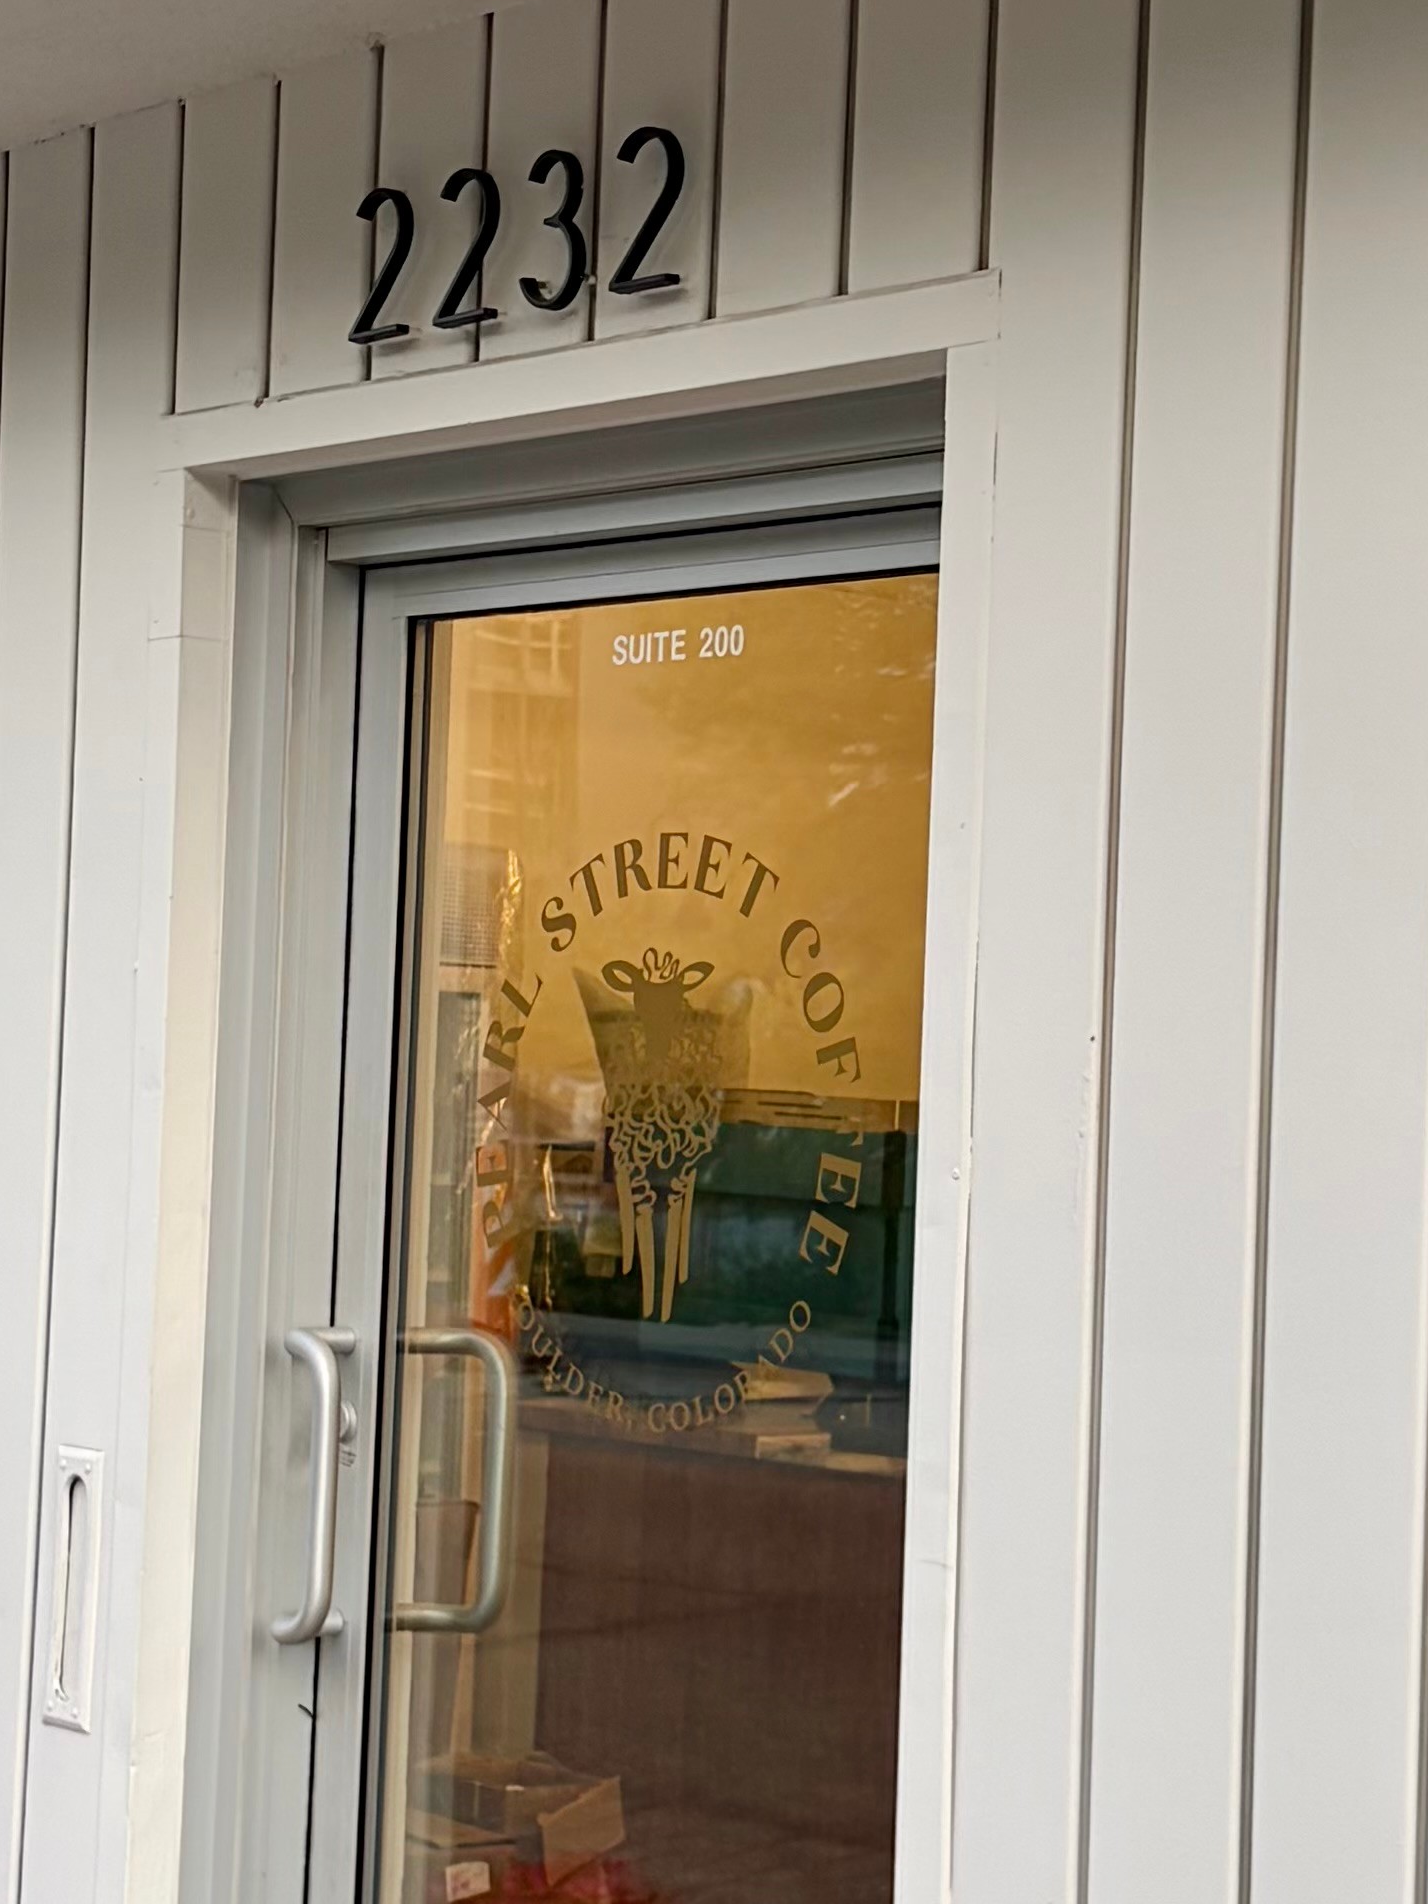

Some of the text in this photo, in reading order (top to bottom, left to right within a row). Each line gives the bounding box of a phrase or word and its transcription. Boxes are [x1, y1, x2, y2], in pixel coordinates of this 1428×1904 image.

[348, 125, 686, 345] 2232
[611, 623, 745, 667] SUITE 200
[540, 831, 781, 953] STREET
